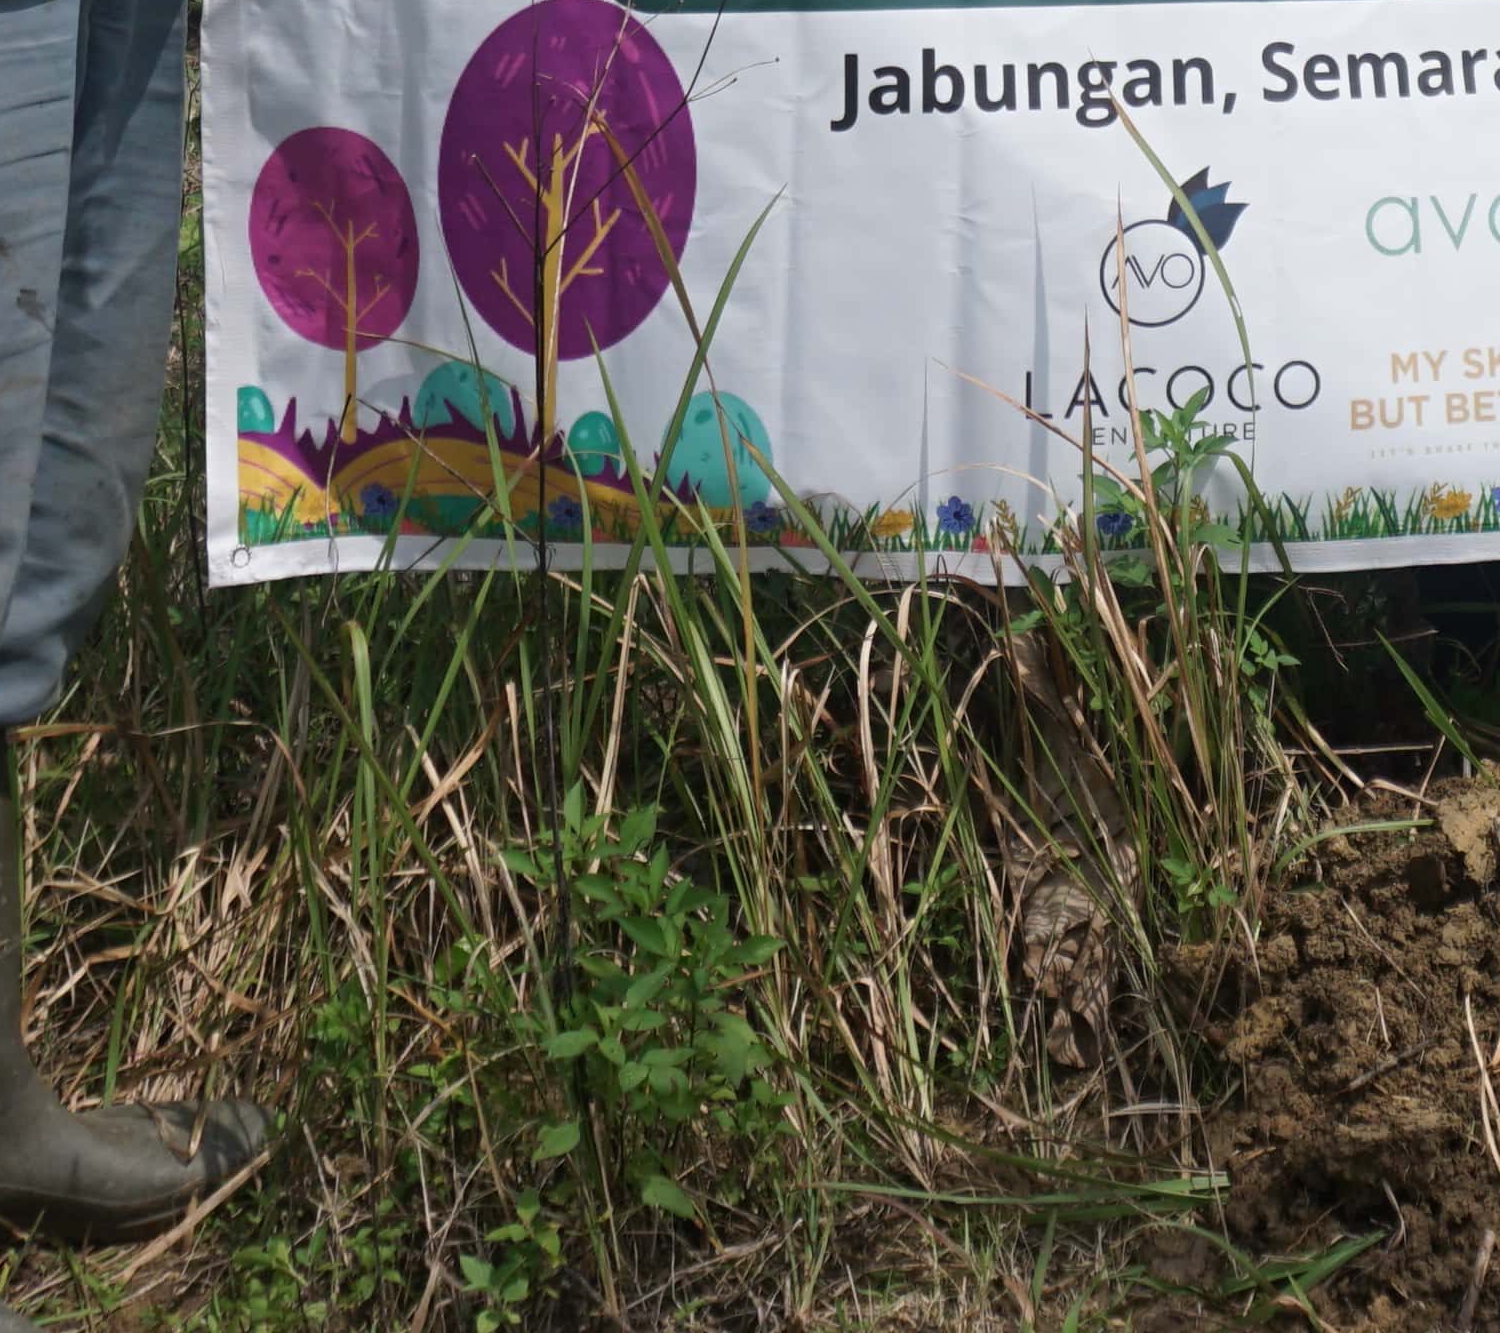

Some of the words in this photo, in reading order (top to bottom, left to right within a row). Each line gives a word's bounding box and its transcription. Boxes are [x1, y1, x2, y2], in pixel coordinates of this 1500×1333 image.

[831, 48, 1236, 132] Jabungan,
[1026, 360, 1321, 419] LACOCO
[1390, 349, 1448, 384] MY
[1350, 394, 1430, 431] BUT
